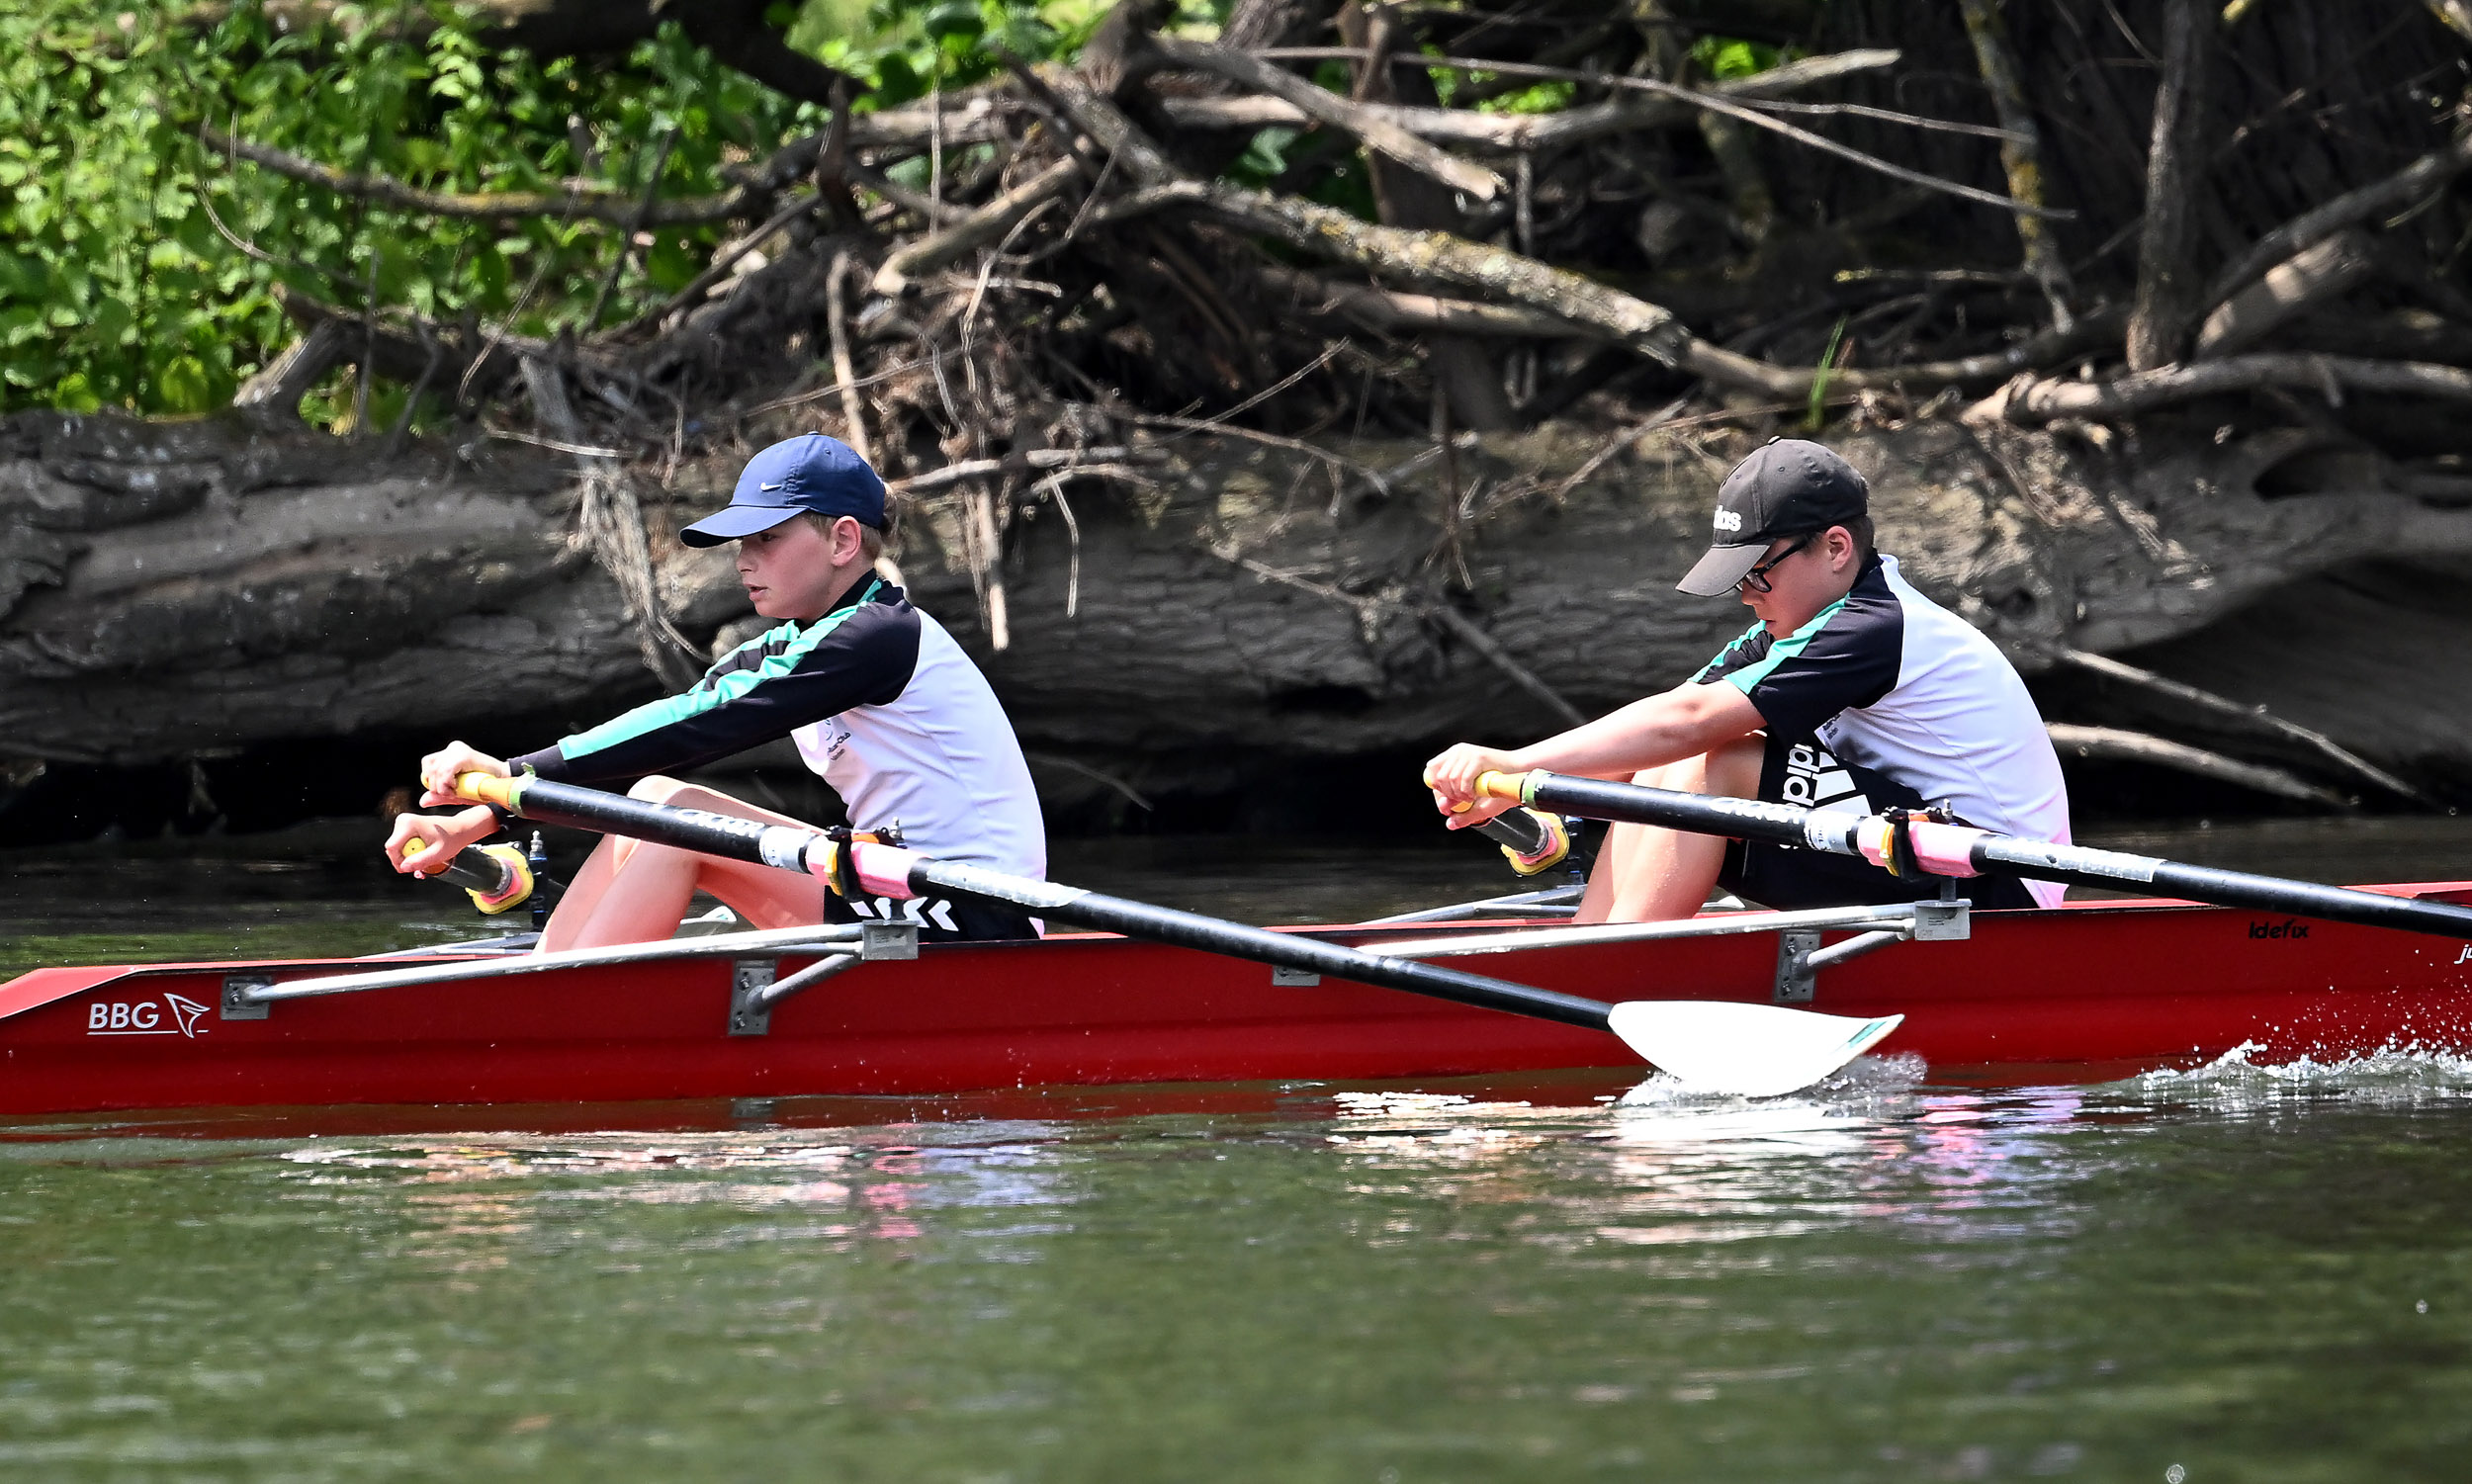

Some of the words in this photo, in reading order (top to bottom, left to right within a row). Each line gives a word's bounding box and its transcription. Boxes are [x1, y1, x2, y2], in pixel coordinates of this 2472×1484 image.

[2249, 918, 2309, 939] Idefix
[2453, 943, 2472, 965] ju
[88, 1002, 159, 1029] BBG
